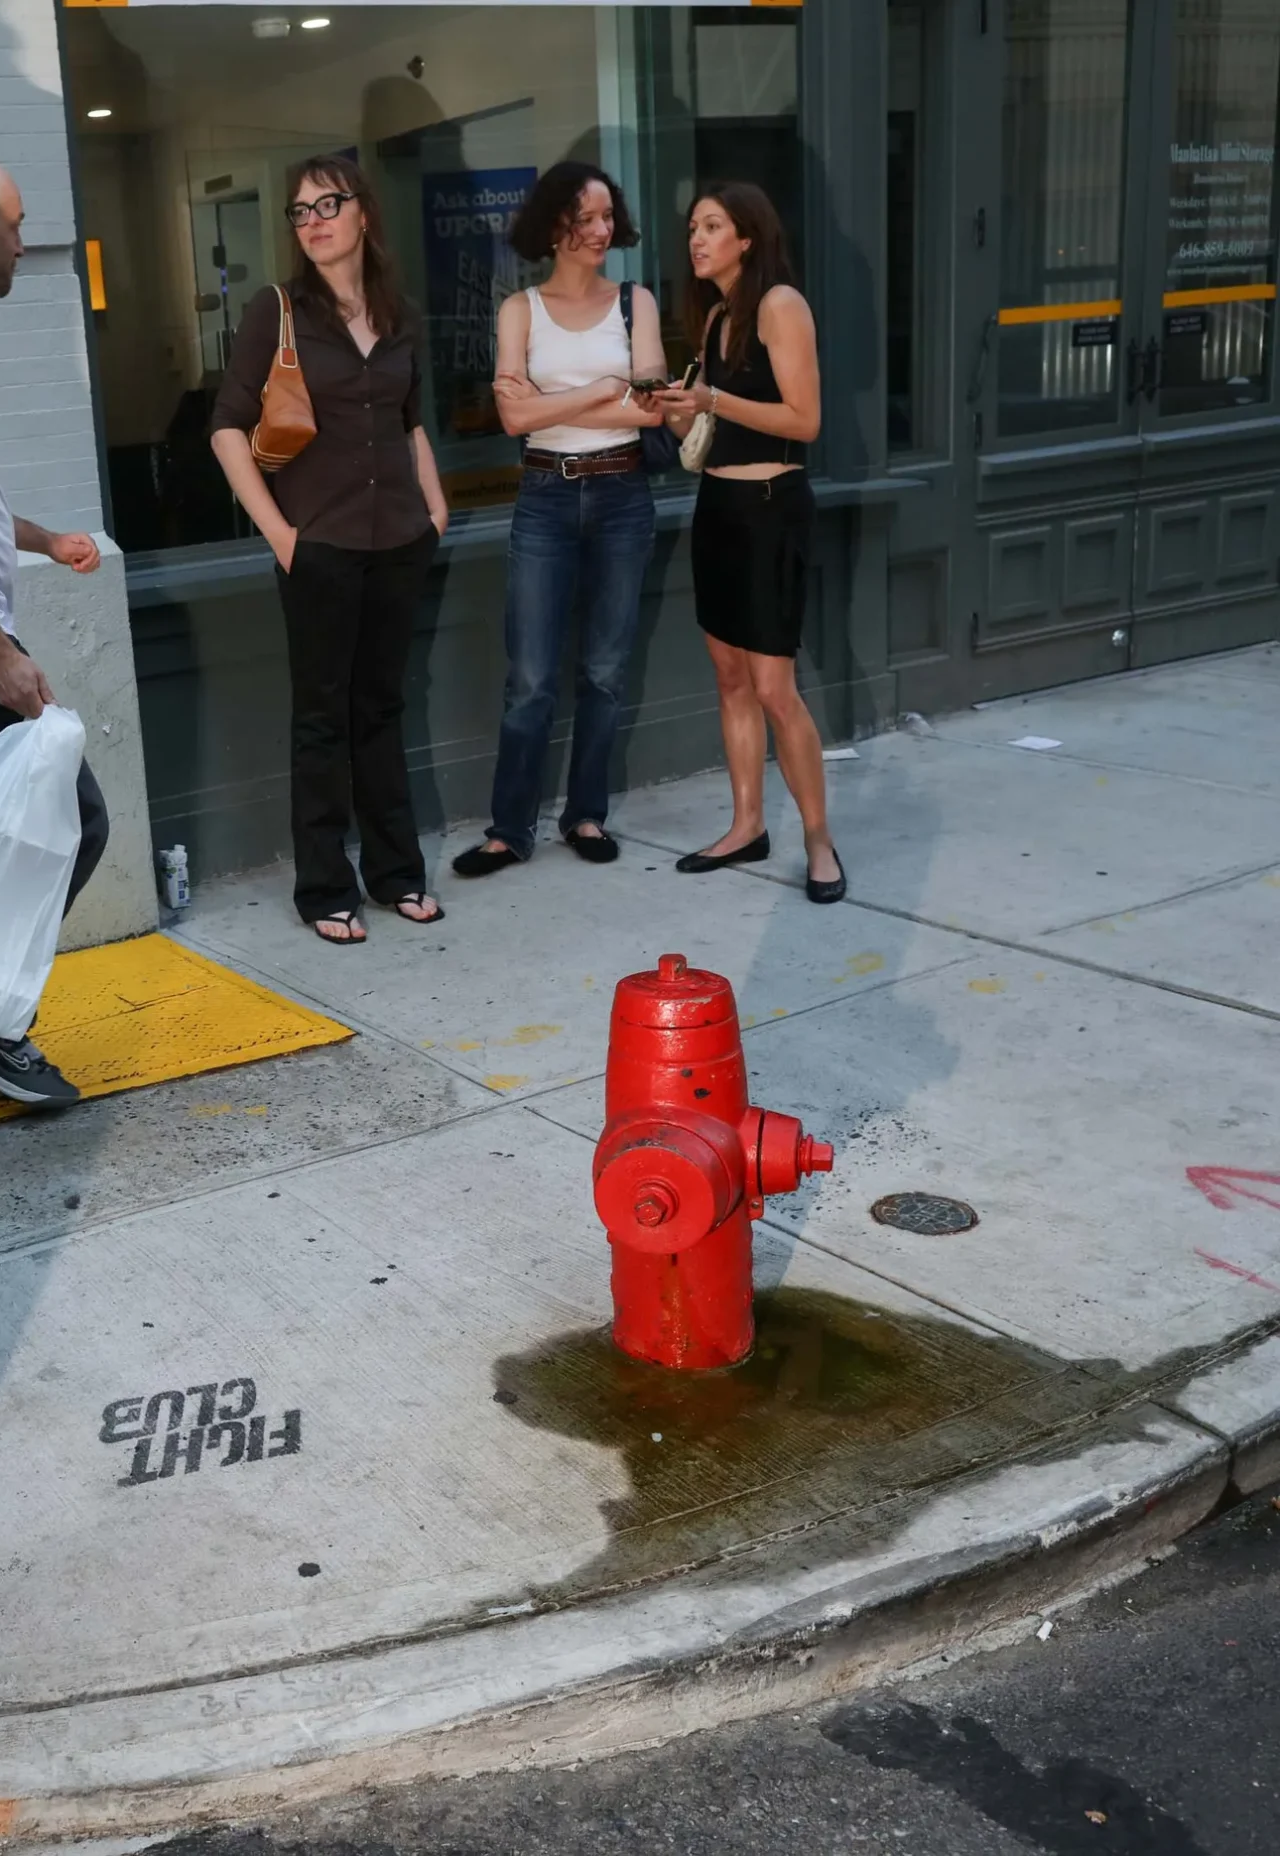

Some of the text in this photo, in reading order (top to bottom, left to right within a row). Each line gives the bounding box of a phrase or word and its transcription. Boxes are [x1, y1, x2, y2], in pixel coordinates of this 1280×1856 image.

[1170, 142, 1218, 164] Manhattan
[433, 188, 525, 209] Ask about
[99, 1377, 257, 1444] CLUB
[117, 1409, 301, 1487] FIGHT
